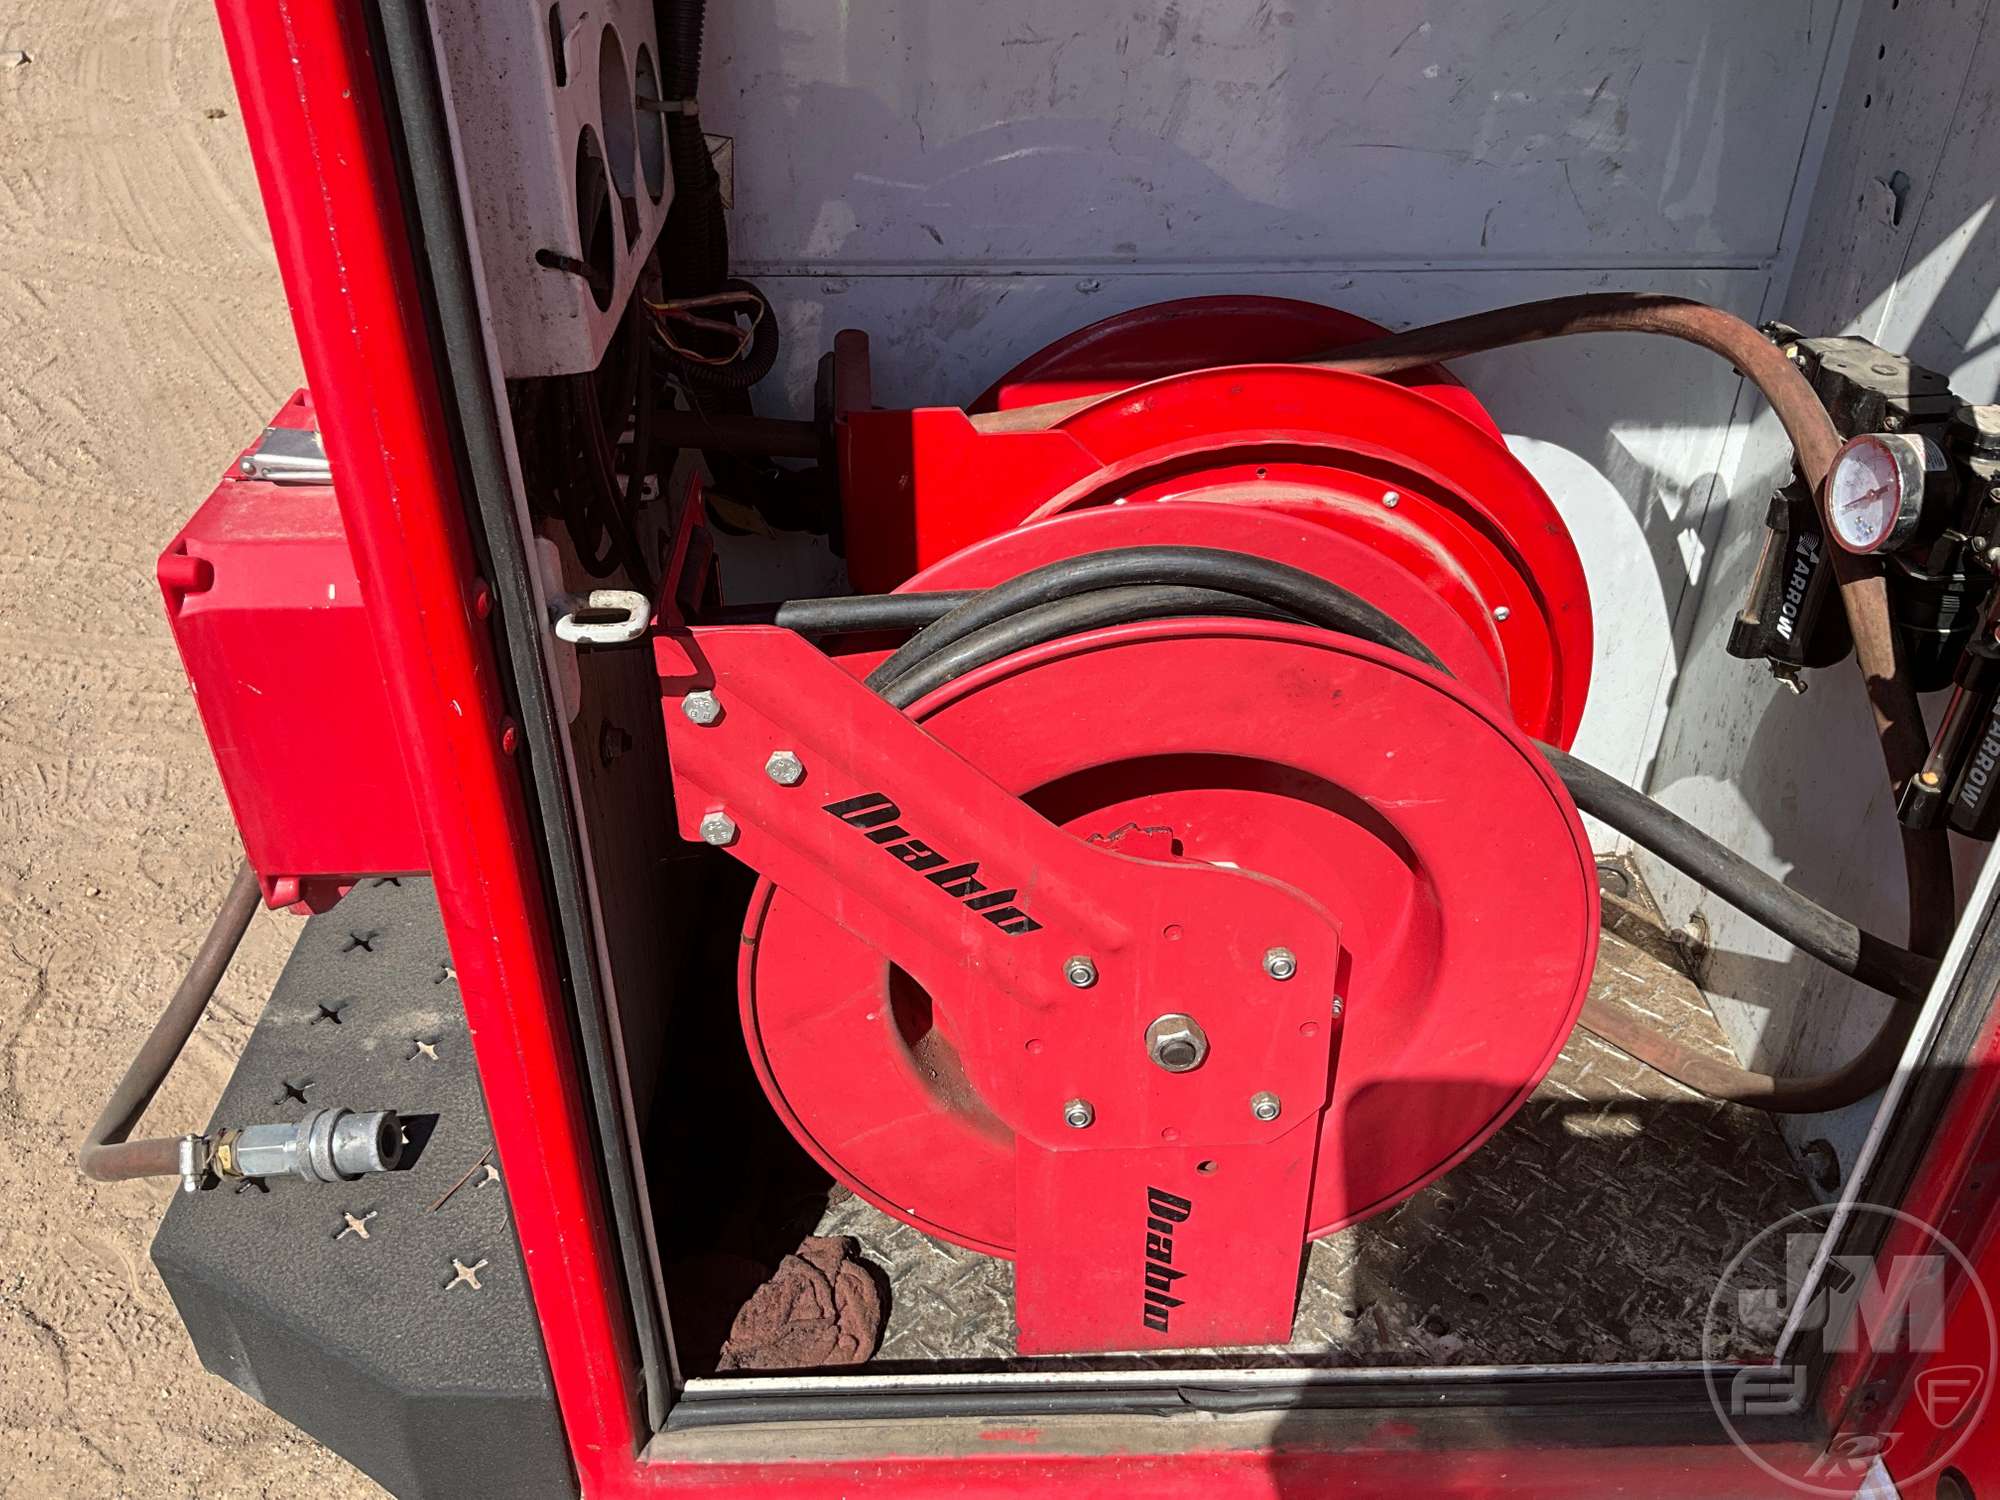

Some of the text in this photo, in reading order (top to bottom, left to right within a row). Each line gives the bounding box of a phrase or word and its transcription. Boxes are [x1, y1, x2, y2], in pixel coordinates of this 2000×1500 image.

[1777, 558, 1810, 640] ARROW
[821, 792, 1044, 936] Diablo
[1143, 1185, 1192, 1334] Diablo
